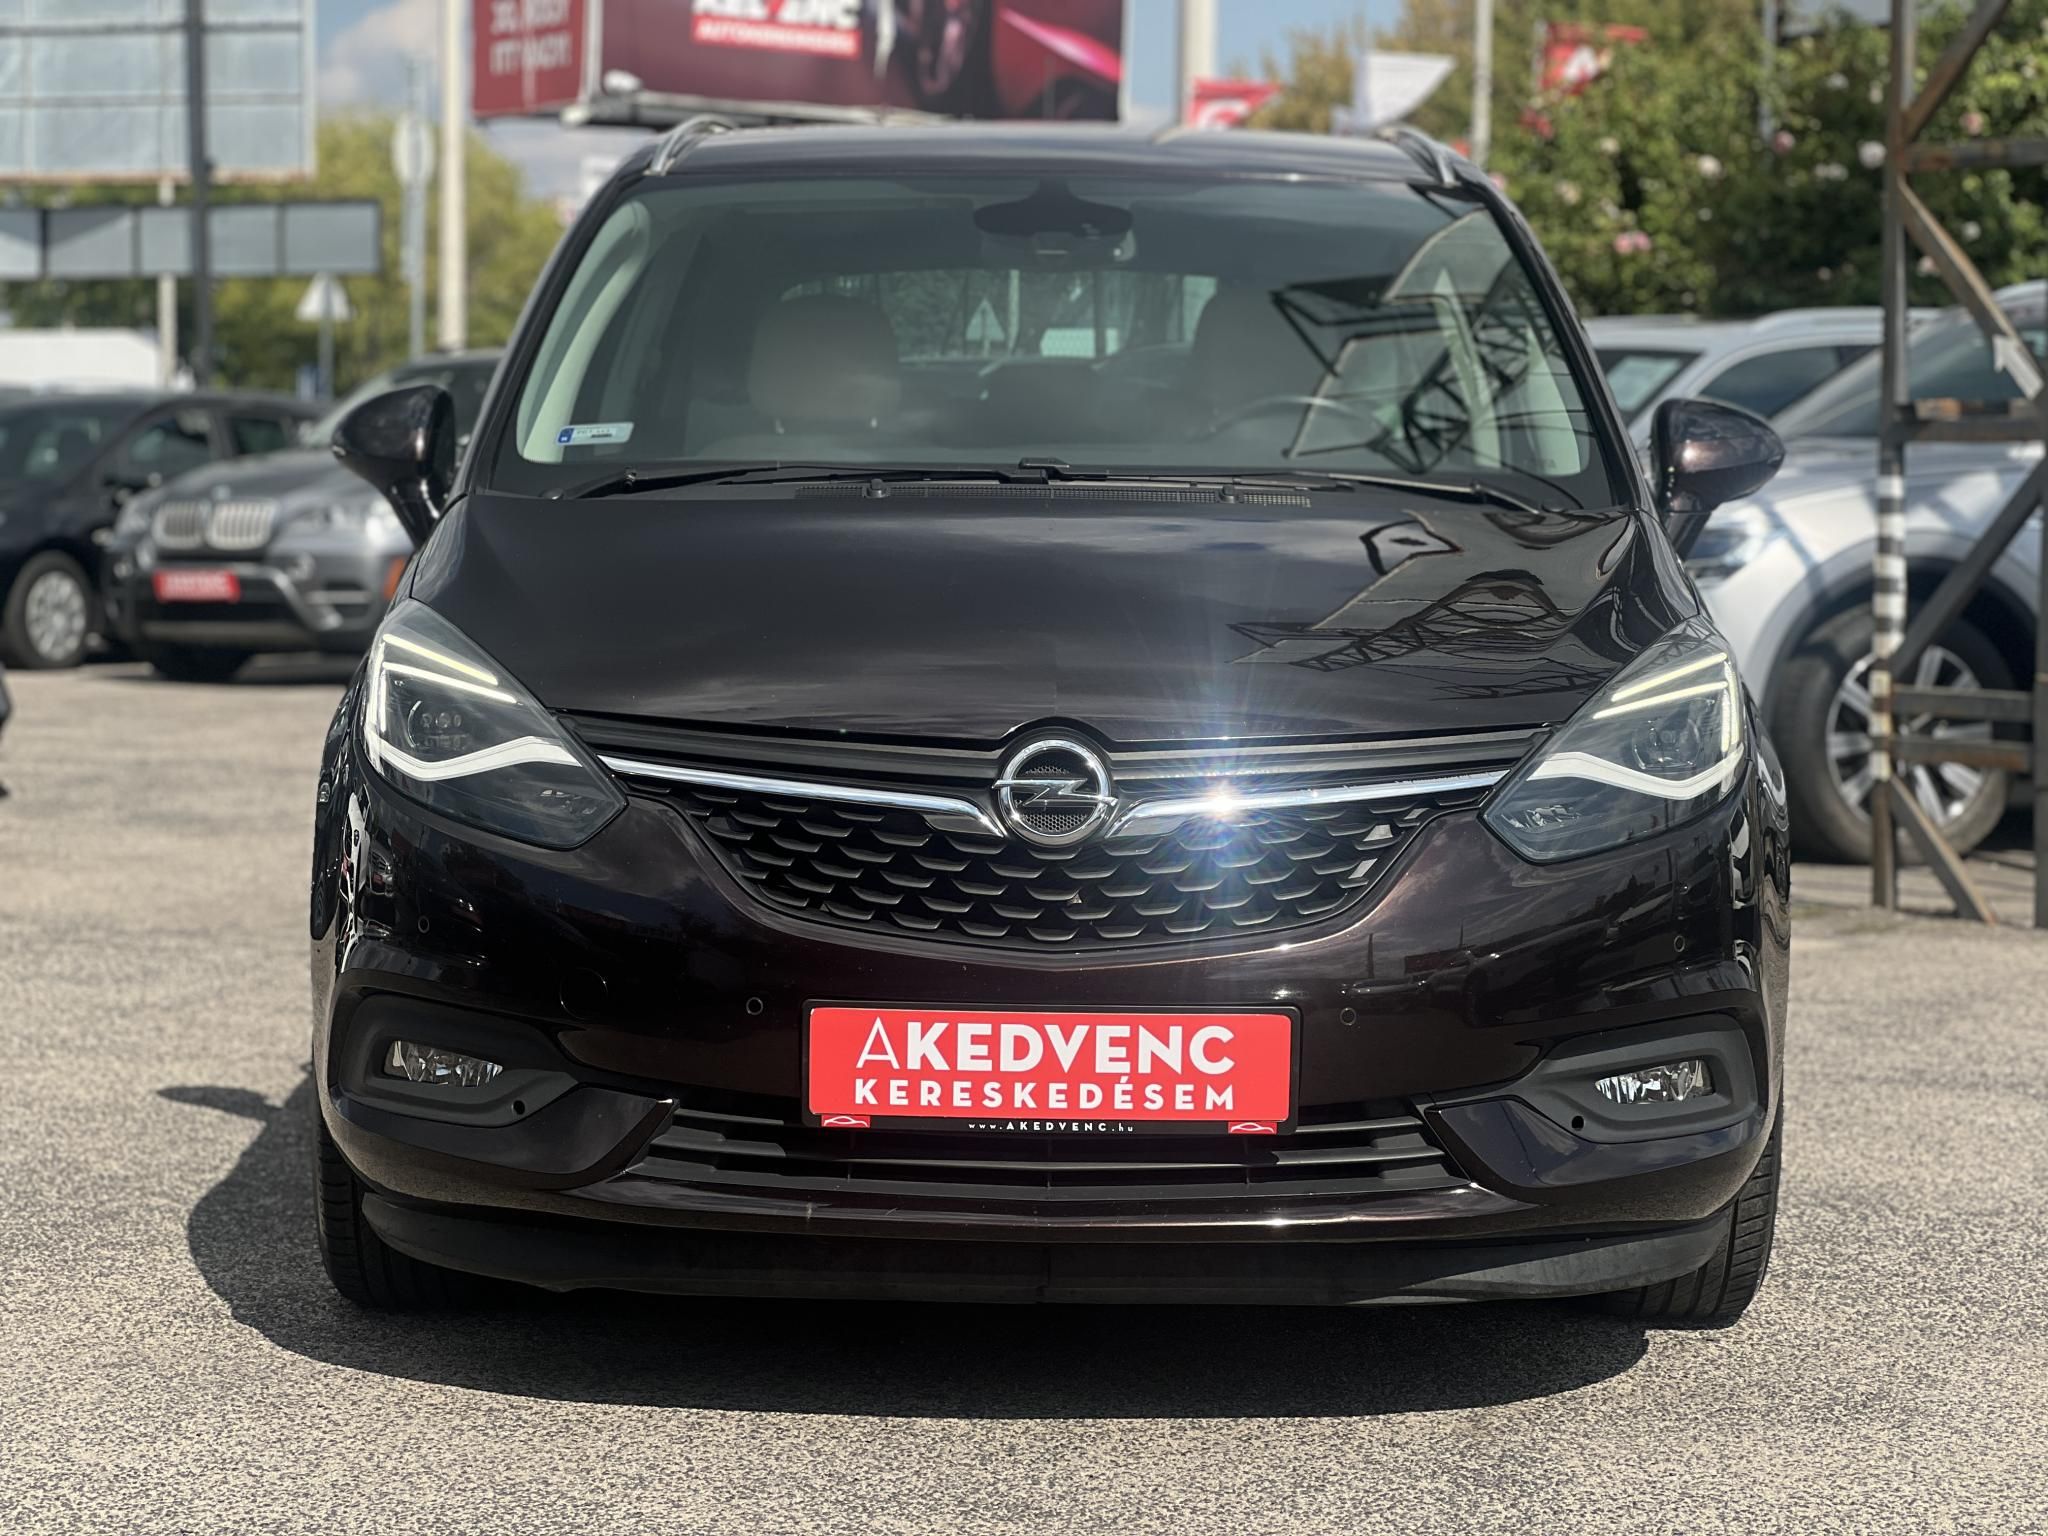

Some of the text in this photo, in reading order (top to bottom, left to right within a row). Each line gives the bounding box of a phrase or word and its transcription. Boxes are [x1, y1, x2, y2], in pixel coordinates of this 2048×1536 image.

[855, 1015, 1236, 1076] AKEDVENC
[854, 1075, 1234, 1111] KERESKEDÉSEM
[968, 1120, 1135, 1133] www.AKEDVENC.hu
